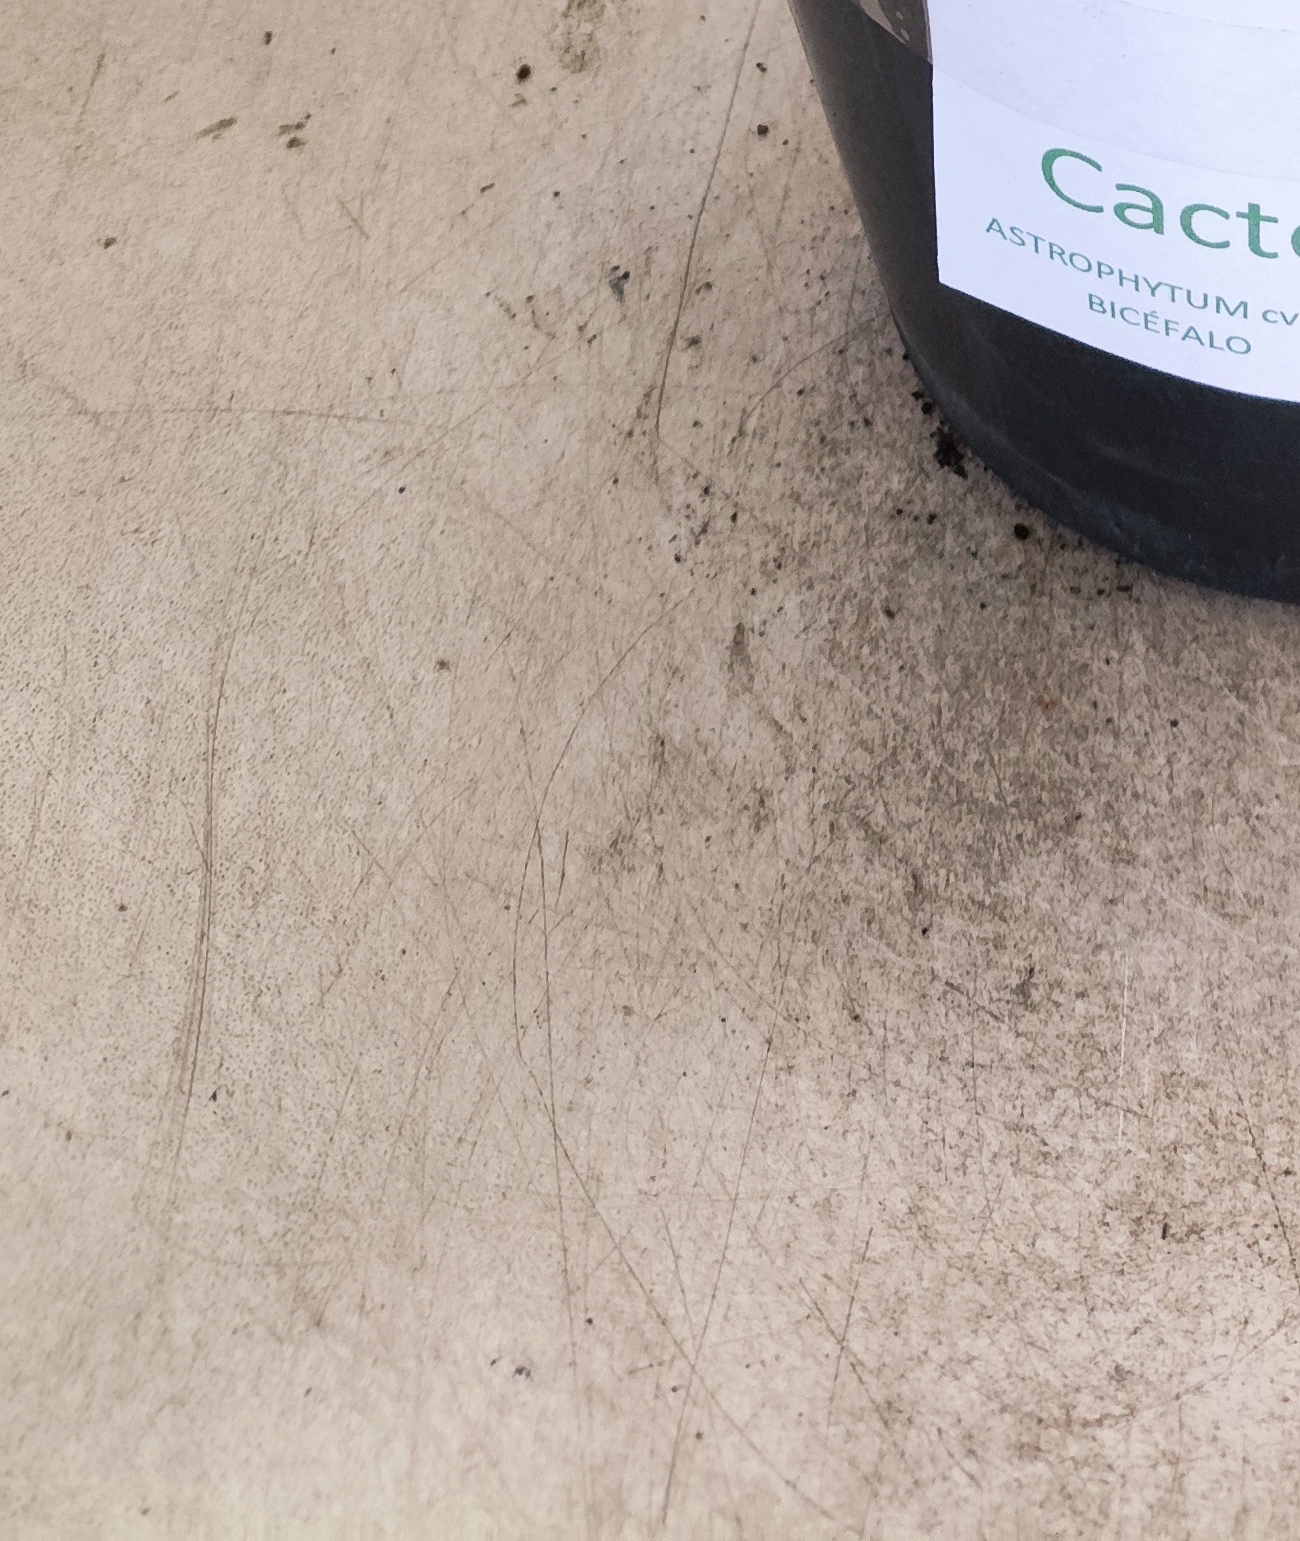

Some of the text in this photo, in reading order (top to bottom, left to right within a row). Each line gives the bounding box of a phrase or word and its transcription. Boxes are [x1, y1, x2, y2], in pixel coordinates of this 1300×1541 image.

[985, 216, 1250, 320] ASTROPHYTUM
[1262, 308, 1299, 327] cv
[1087, 291, 1252, 357] BICÉFALO
